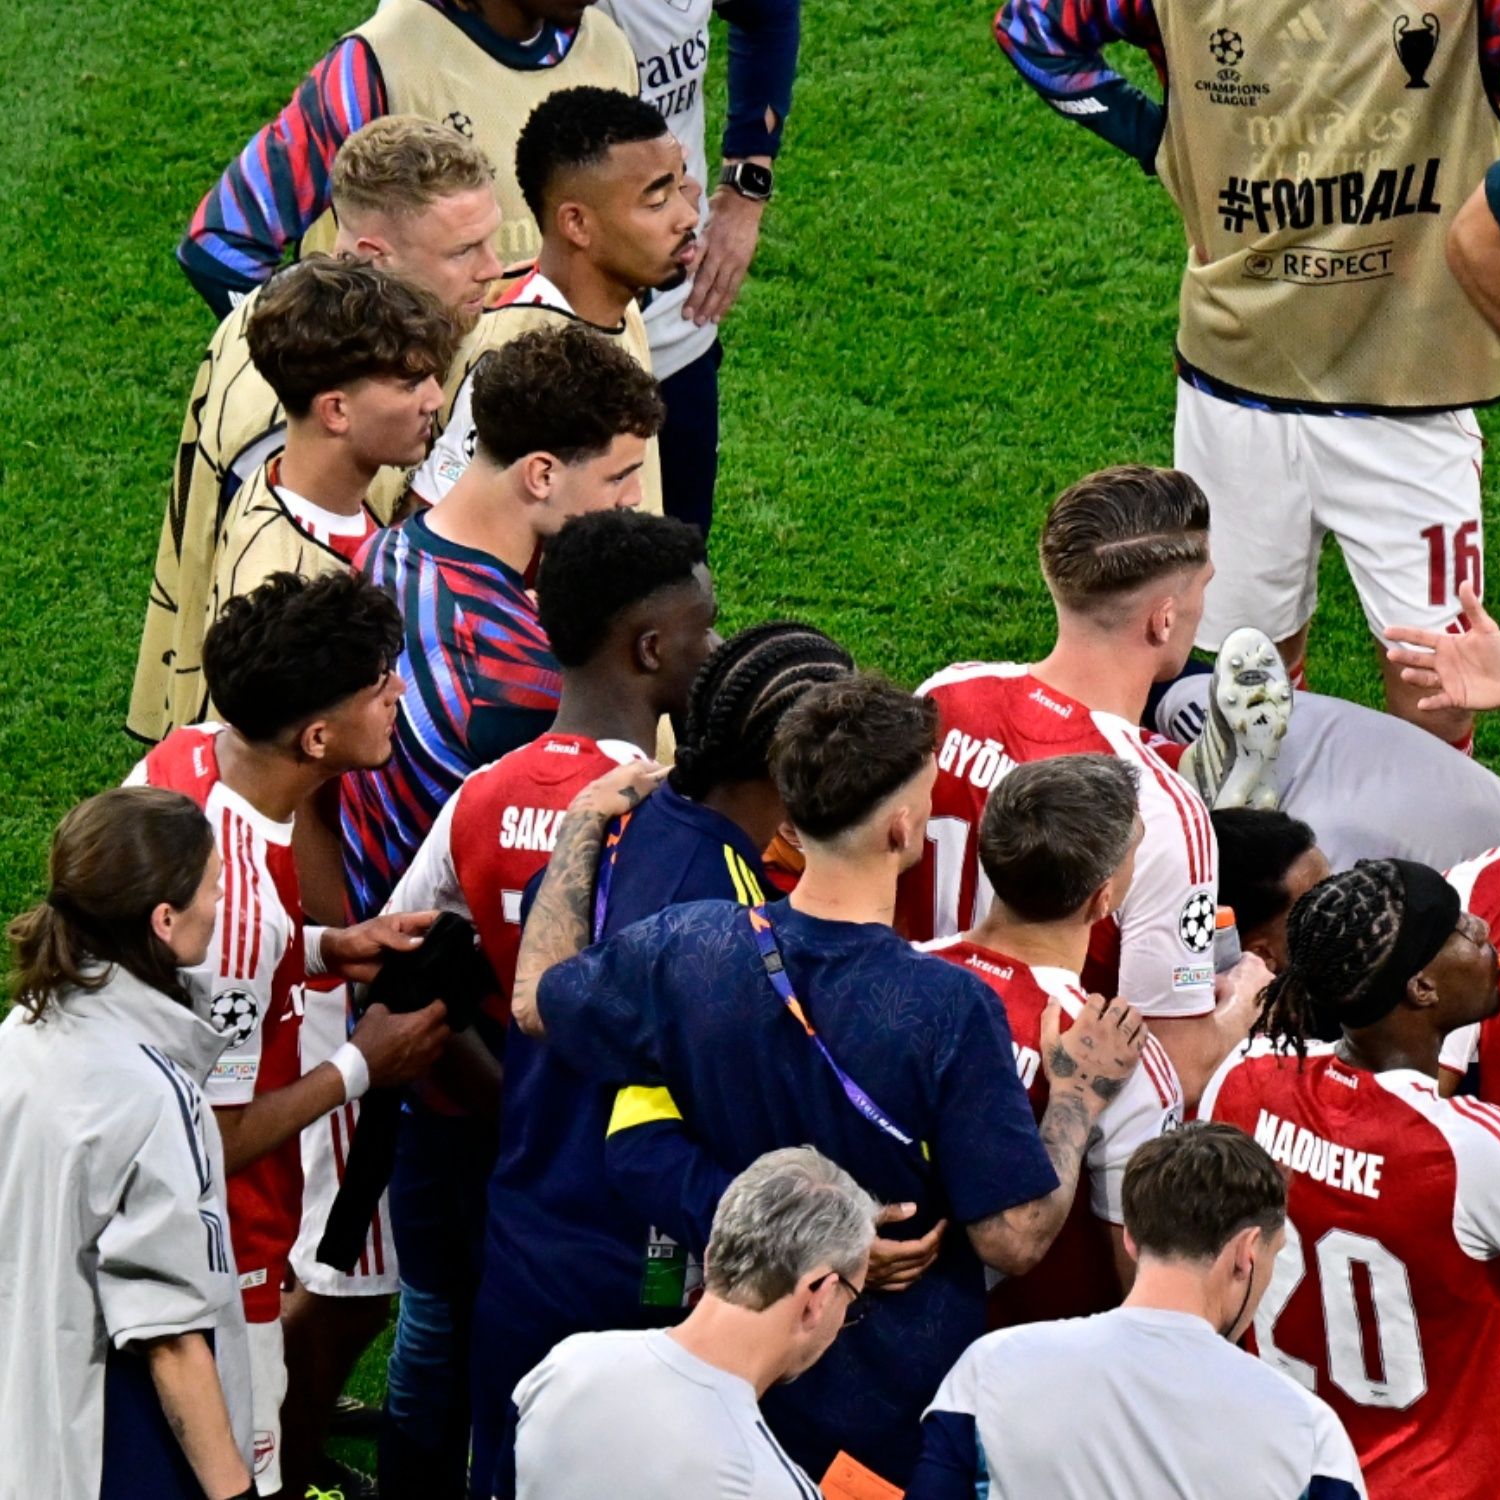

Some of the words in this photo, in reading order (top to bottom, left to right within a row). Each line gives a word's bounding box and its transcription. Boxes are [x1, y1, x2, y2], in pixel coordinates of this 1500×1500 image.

[1194, 80, 1270, 95] CHAMPIONS
[1209, 92, 1257, 106] LEAGUE
[1218, 158, 1441, 233] #FOOTBALL
[1283, 249, 1392, 279] RESPECT
[1420, 519, 1481, 606] 16
[1254, 1108, 1384, 1199] MADUEKE
